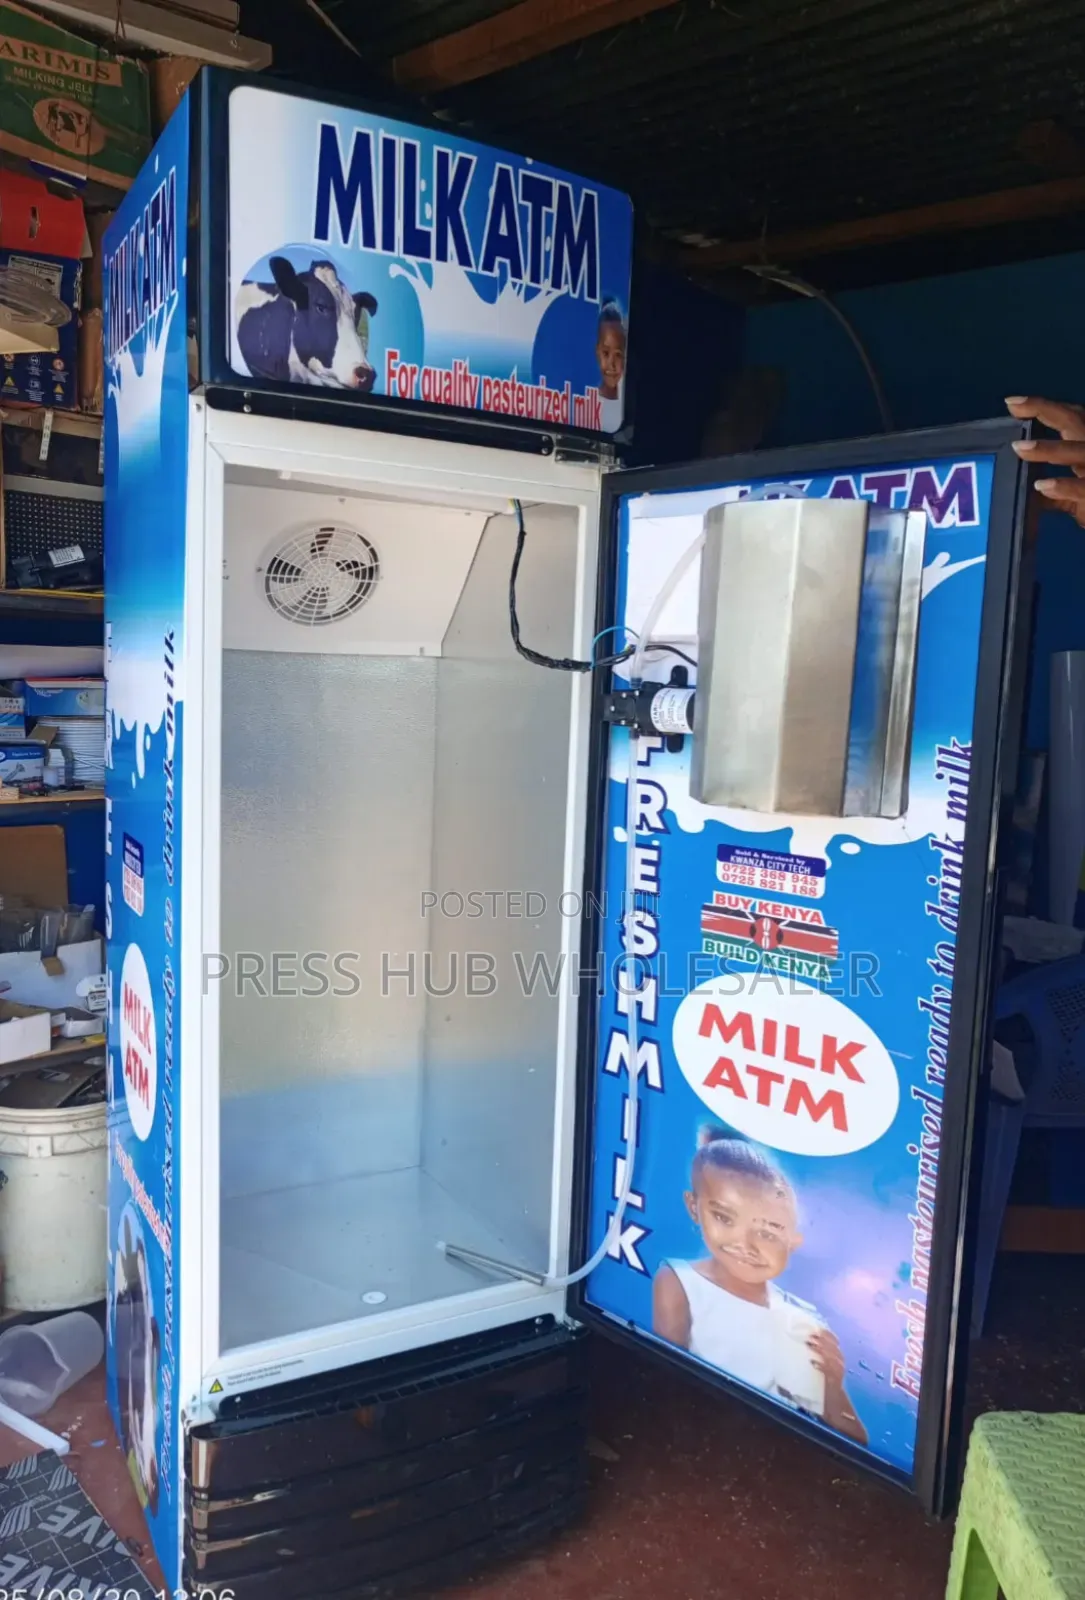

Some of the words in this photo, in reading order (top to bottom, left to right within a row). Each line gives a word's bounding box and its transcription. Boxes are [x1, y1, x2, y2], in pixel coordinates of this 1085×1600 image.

[0, 40, 111, 81] ARIMIS
[13, 66, 65, 88] MILKING
[313, 121, 477, 271] MILK
[479, 163, 600, 302] ATM
[109, 217, 145, 359] MILK
[142, 165, 177, 325] ATM
[385, 348, 418, 398] For
[421, 356, 479, 409] quality
[482, 375, 571, 425] pasteurized
[573, 386, 603, 432] milk
[163, 622, 175, 738] milk
[935, 737, 972, 822] milk
[162, 754, 175, 887] drink
[721, 873, 755, 886] 0725
[760, 879, 784, 891] 821
[792, 885, 818, 898] 188
[722, 863, 756, 877] 0722
[760, 868, 787, 882] 368
[791, 874, 818, 887] 945
[730, 856, 765, 868] KWANZA
[767, 861, 787, 871] CITY
[788, 864, 811, 875] TECH
[927, 831, 966, 936] drink
[163, 897, 174, 947] to
[715, 893, 753, 911] BUY
[758, 901, 823, 925] KENYA
[704, 940, 759, 964] BUILD
[764, 952, 830, 979] KENYA
[927, 941, 956, 980] to
[124, 981, 152, 1055] MILK
[698, 1003, 867, 1084] MILK
[125, 1040, 150, 1111] ATM
[702, 1055, 849, 1133] ATM
[602, 1026, 666, 1279] MILK
